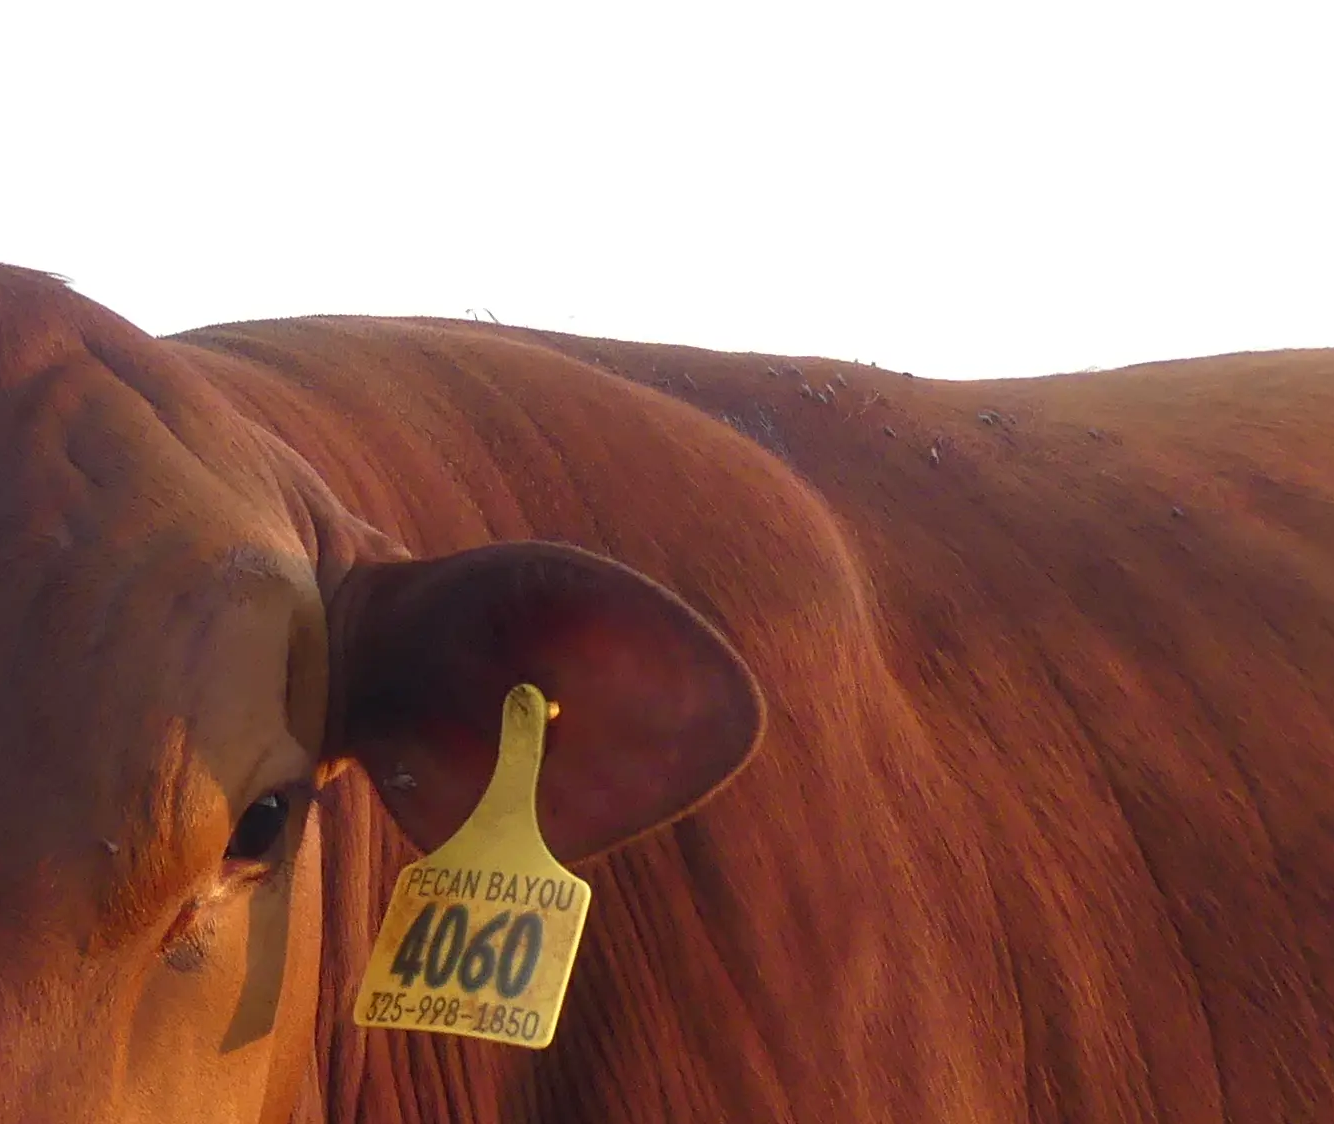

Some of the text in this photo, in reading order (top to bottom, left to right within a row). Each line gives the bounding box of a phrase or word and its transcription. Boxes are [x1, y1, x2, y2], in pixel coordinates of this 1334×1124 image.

[405, 867, 577, 911] PECAN BAYOU
[390, 901, 544, 999] 4060
[365, 991, 540, 1041] 325-998-1850
